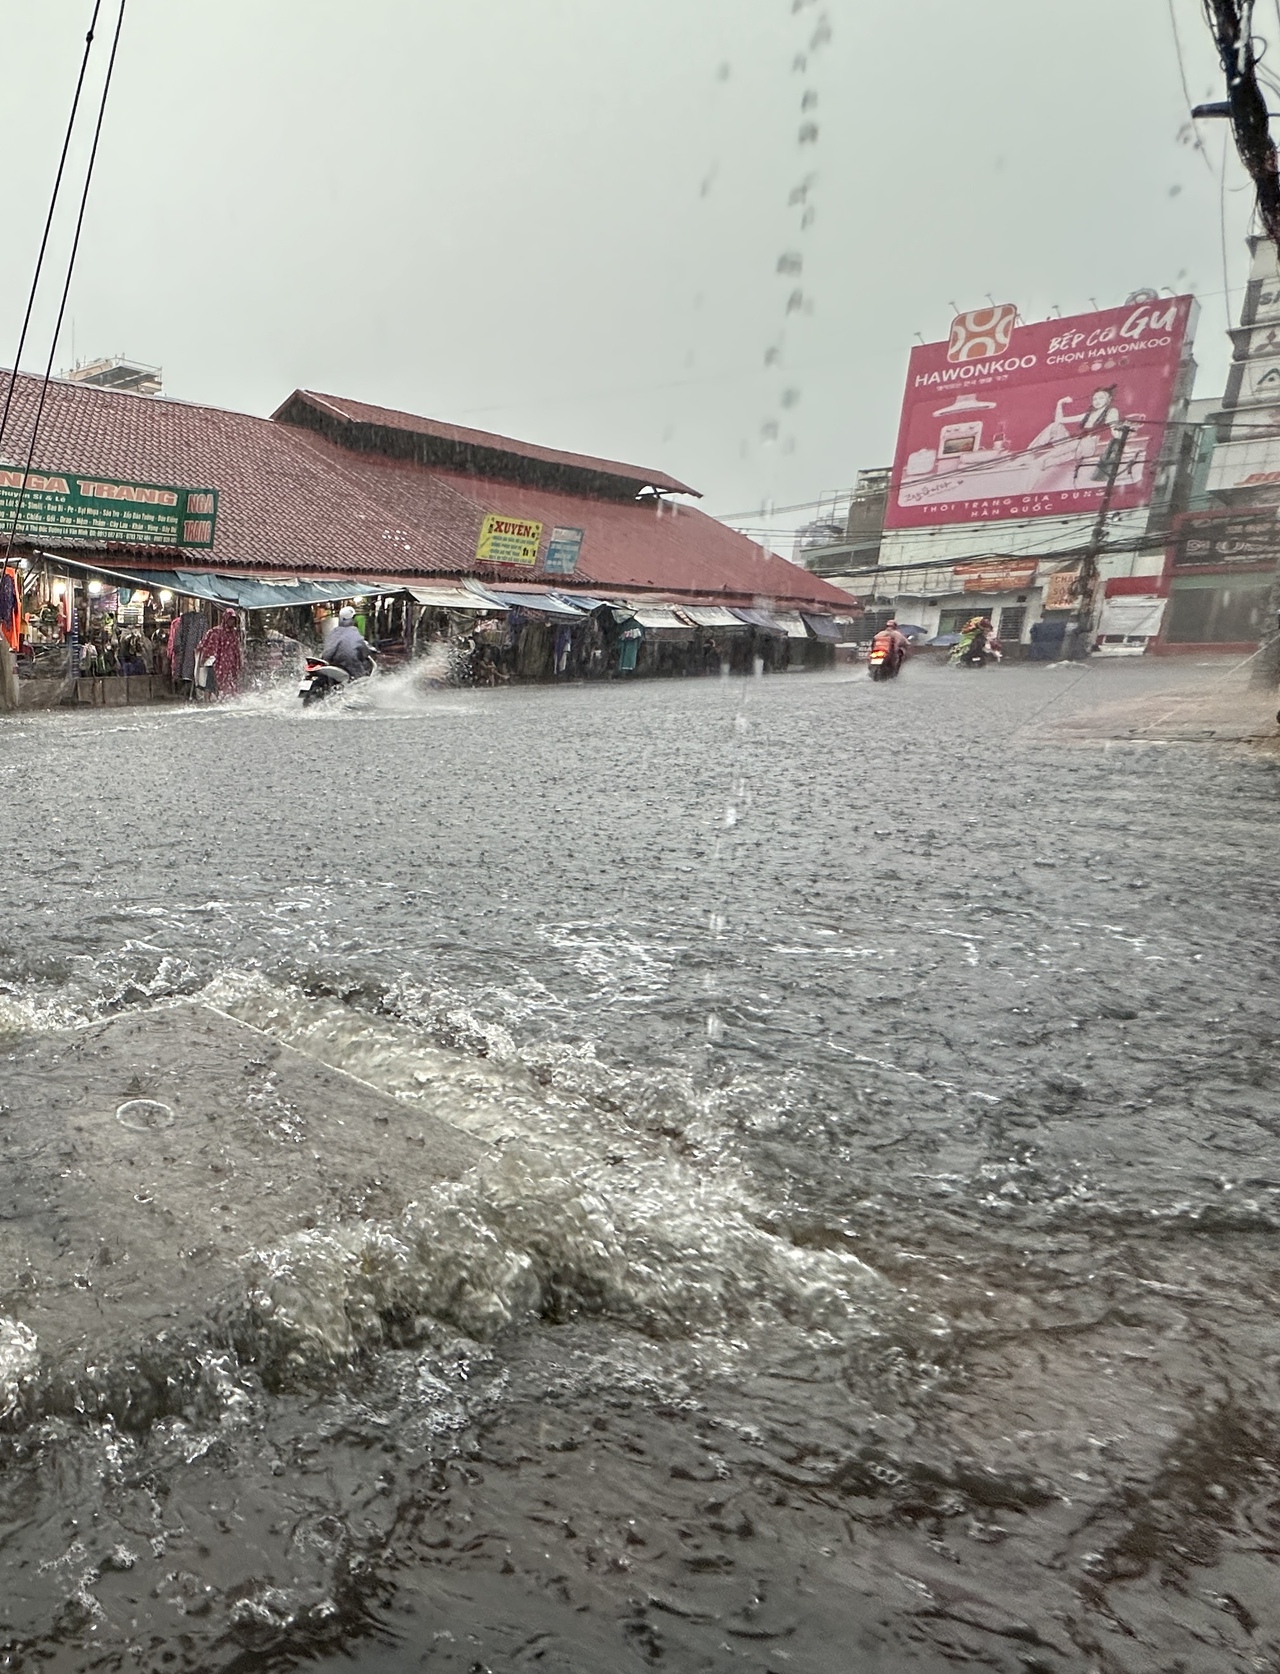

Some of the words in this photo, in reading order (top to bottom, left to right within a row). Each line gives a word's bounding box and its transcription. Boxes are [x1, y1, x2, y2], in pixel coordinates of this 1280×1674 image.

[1088, 336, 1171, 358] HAWONKOO
[914, 354, 1037, 388] HAWONKOO
[77, 480, 178, 507] TRANG
[187, 493, 215, 514] NGA
[963, 498, 1012, 510] TRANG
[1021, 494, 1050, 504] GIA
